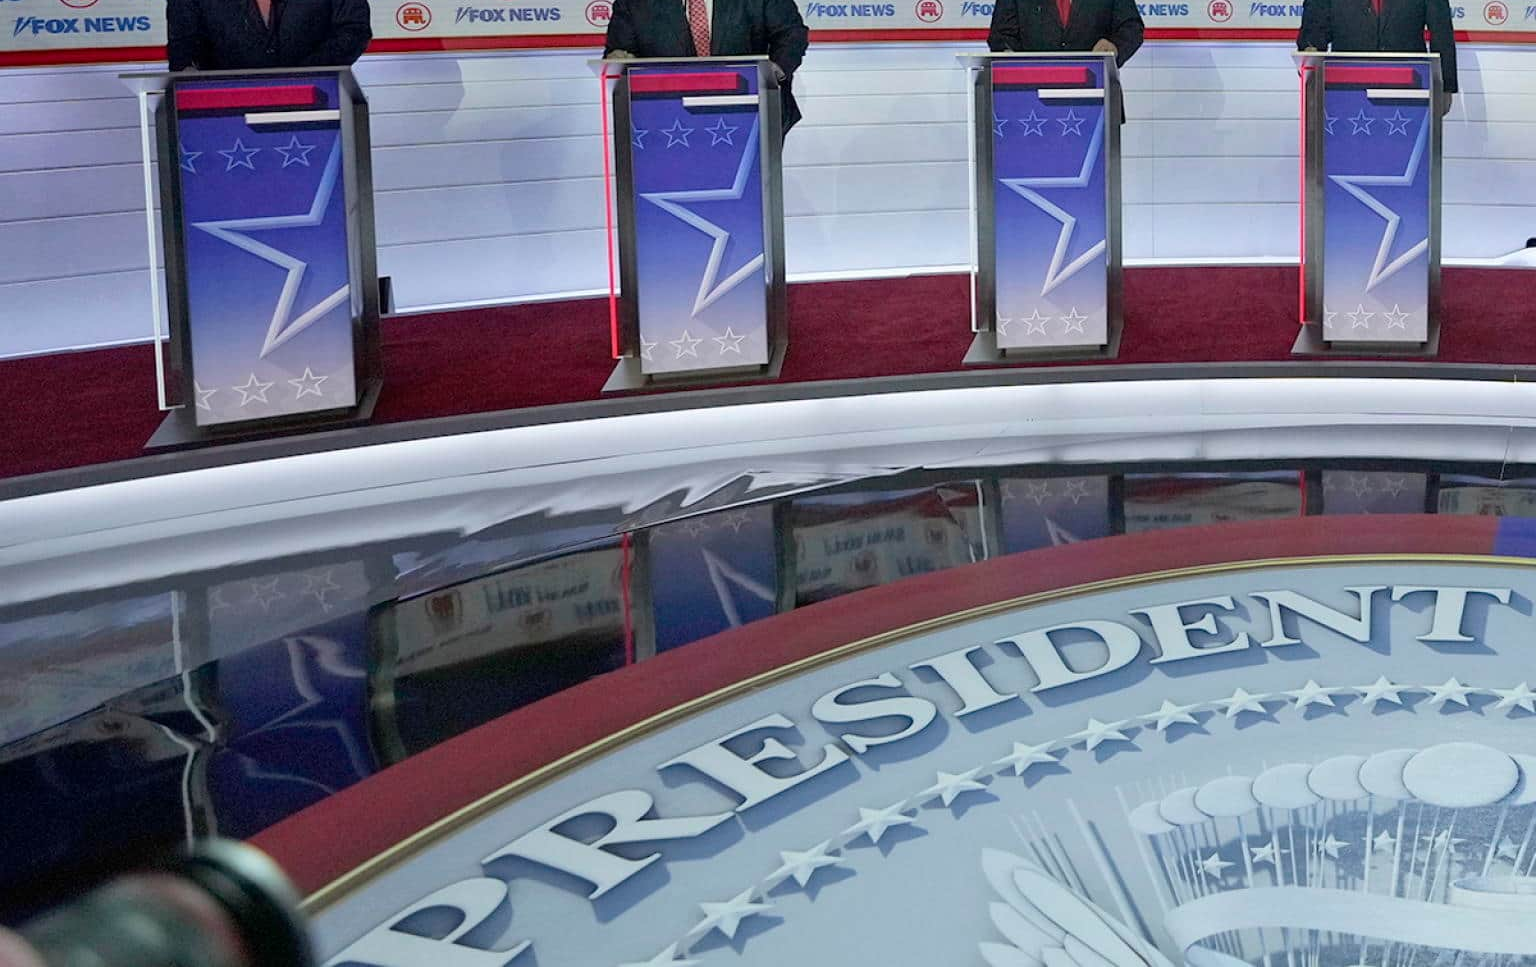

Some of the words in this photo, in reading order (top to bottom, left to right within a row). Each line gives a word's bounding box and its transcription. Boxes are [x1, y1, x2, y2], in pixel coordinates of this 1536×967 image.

[469, 7, 505, 22] FOX
[509, 7, 561, 21] NEWS
[817, 4, 848, 17] FOX
[851, 4, 895, 16] NEWS
[1149, 4, 1189, 16] NEWS
[1260, 4, 1286, 16] FOX
[33, 18, 79, 34] FOX
[84, 16, 150, 32] NEWS
[322, 583, 1514, 967] PRESIDENT
